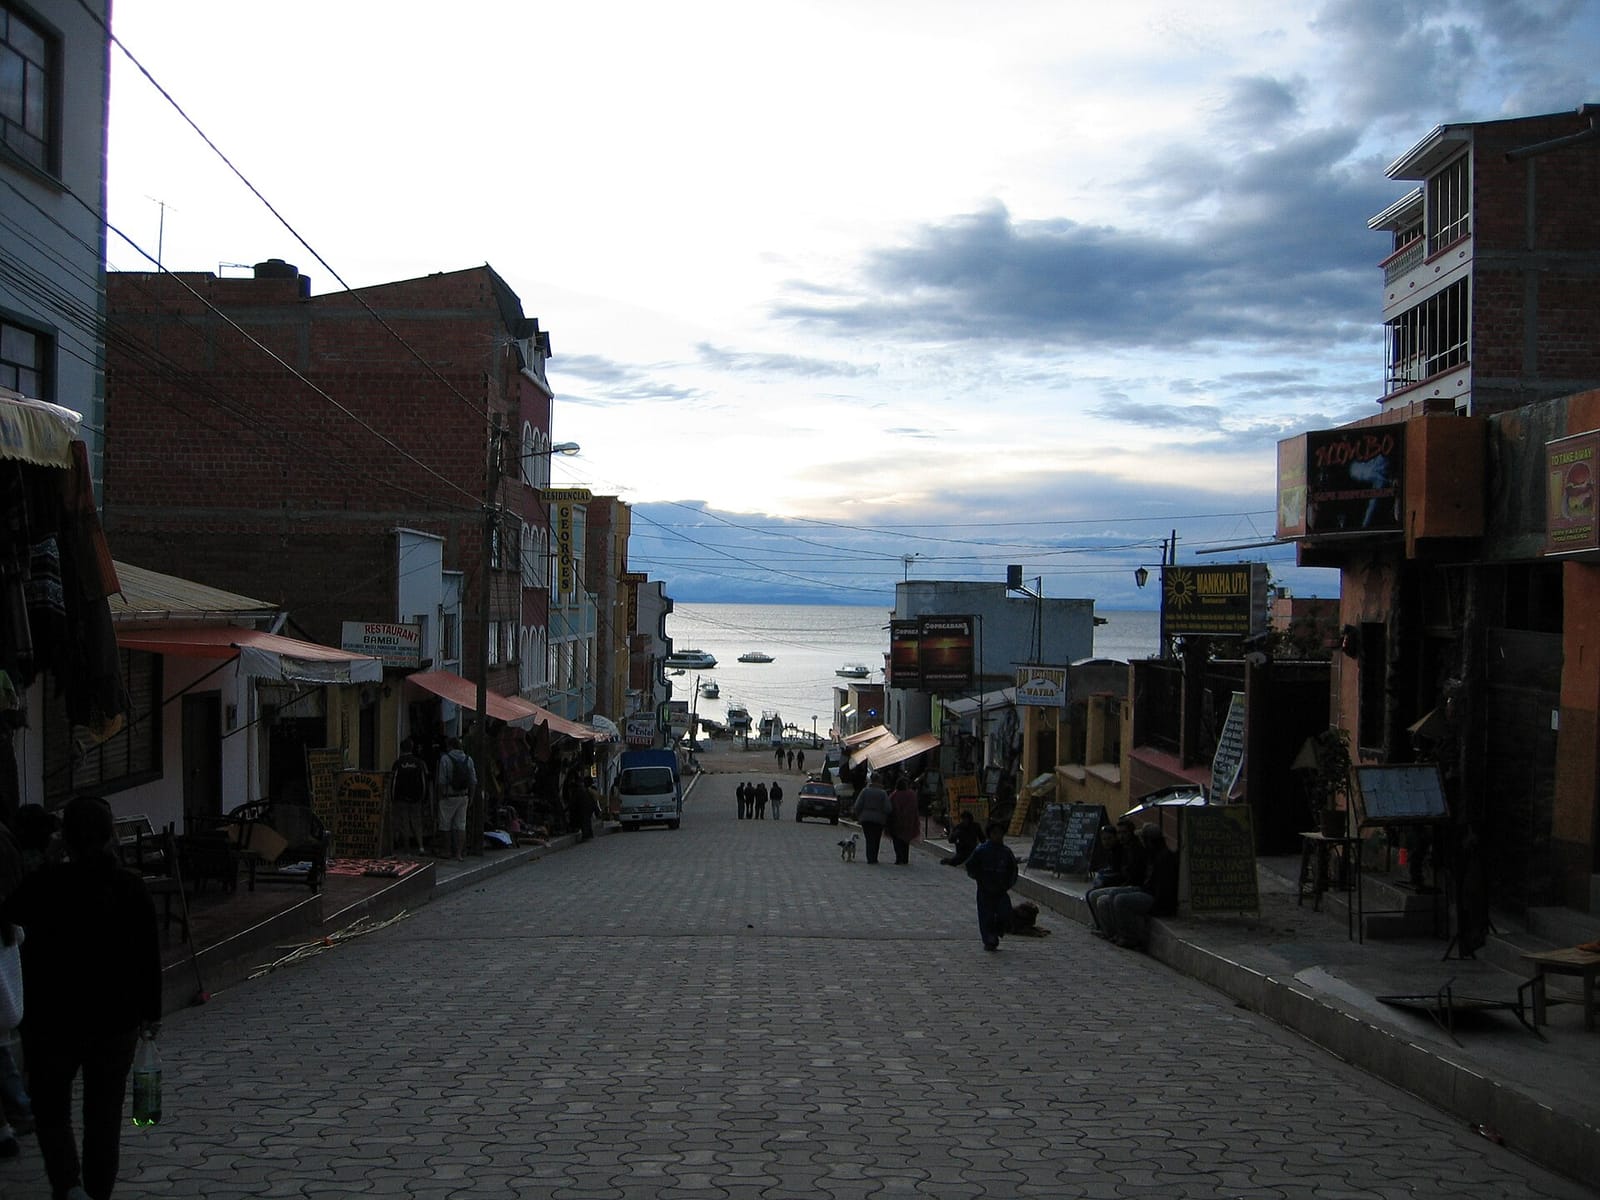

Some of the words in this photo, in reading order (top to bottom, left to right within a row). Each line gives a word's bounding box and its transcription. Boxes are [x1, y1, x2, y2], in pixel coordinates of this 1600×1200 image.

[542, 490, 591, 501] RESIDENCIAL
[561, 507, 570, 589] GEORGES
[1197, 573, 1231, 594] MANKHA
[1232, 572, 1249, 593] UTA
[364, 636, 399, 645] BAMBU
[365, 624, 418, 643] RESTAURANT
[635, 728, 655, 737] Entel
